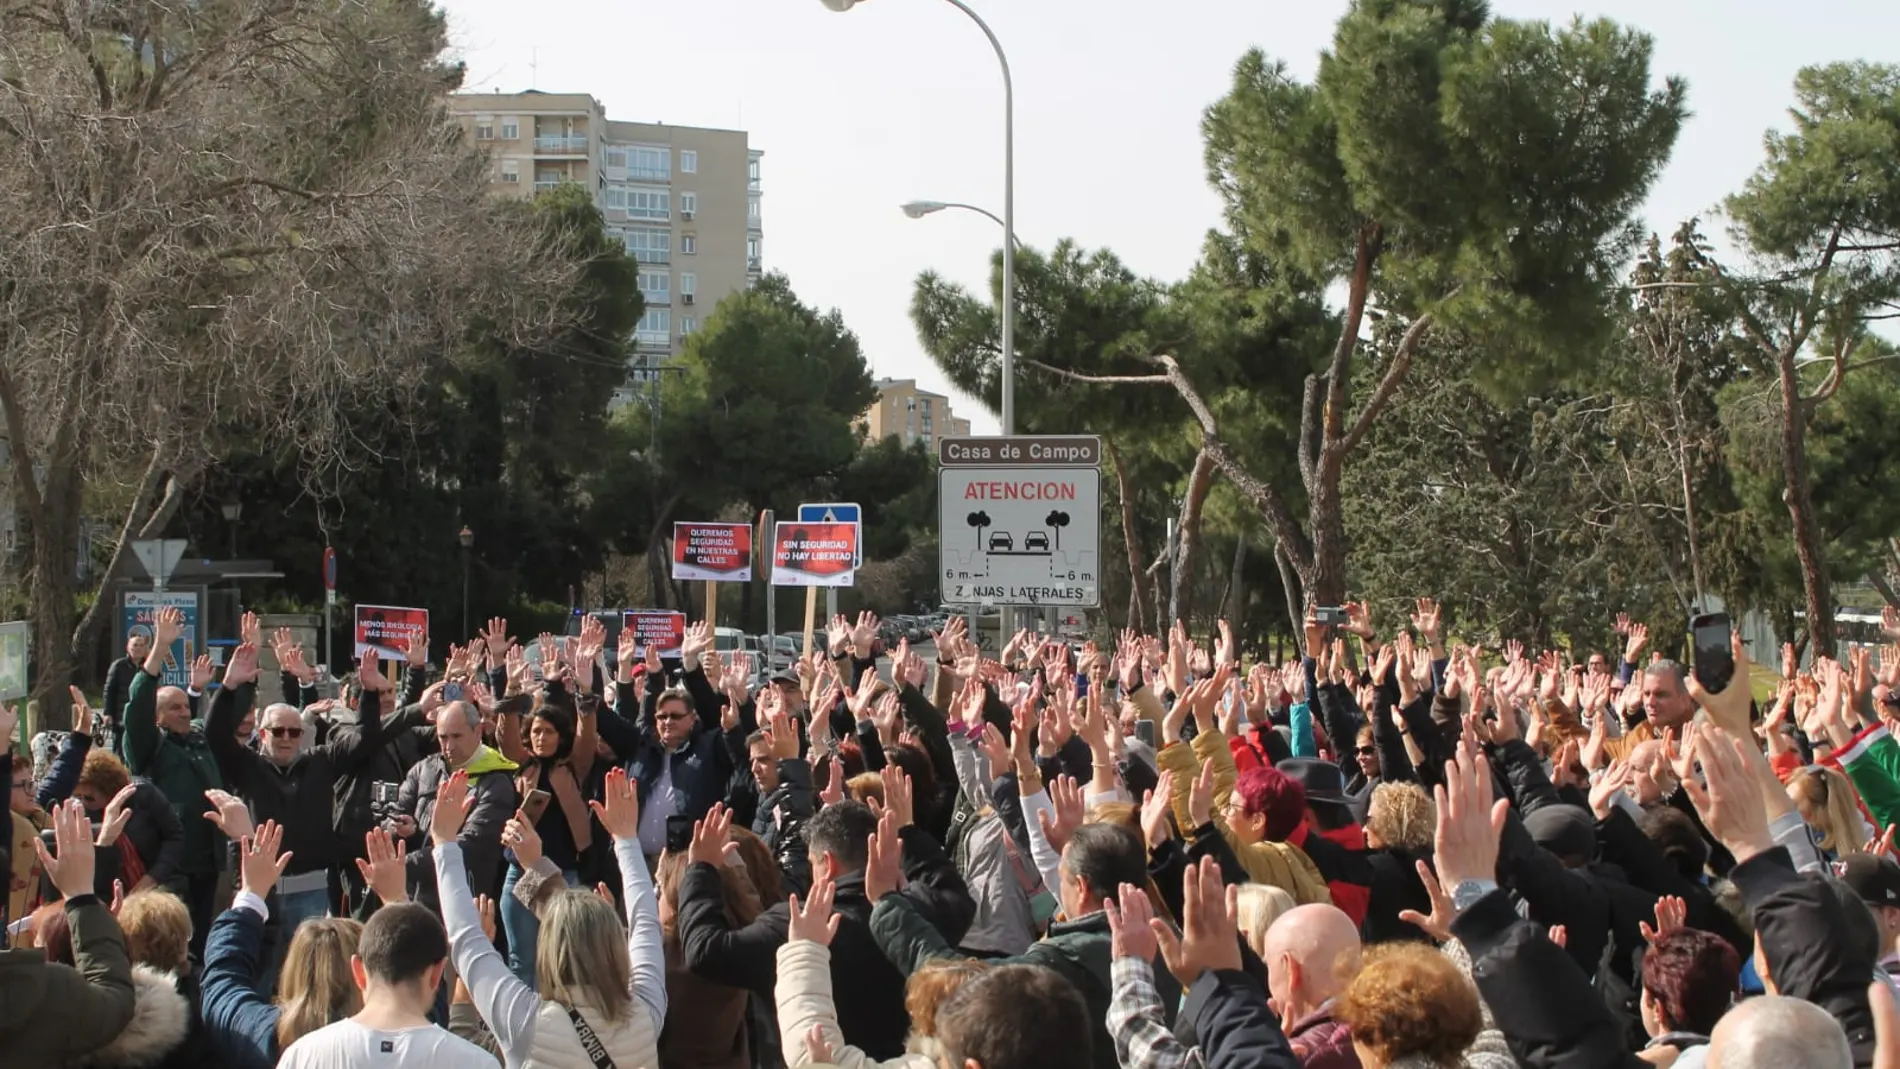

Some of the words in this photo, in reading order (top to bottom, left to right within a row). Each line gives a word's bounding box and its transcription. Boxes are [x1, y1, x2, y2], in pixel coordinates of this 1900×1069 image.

[948, 444, 991, 459] Casa
[1000, 444, 1021, 459] de
[1029, 444, 1091, 461] Campo
[964, 482, 1076, 499] ATENCION
[690, 528, 734, 537] QUEREMOS
[690, 537, 734, 546] SEGURIDAD
[783, 540, 798, 549] SIN
[799, 540, 848, 549] SEGURIDAD
[685, 546, 697, 555] EN
[697, 547, 739, 556] NUESTRAS
[777, 552, 790, 560] NO
[792, 552, 810, 560] HAY
[811, 552, 852, 560] LIBERTAD
[696, 556, 727, 564] CALLES
[946, 569, 954, 579] 6
[1067, 570, 1076, 581] 6
[955, 585, 1004, 597] ZNJAS
[1010, 586, 1084, 599] LATERALES
[360, 620, 386, 629] MENOS
[574, 1017, 606, 1062] BIMBA
